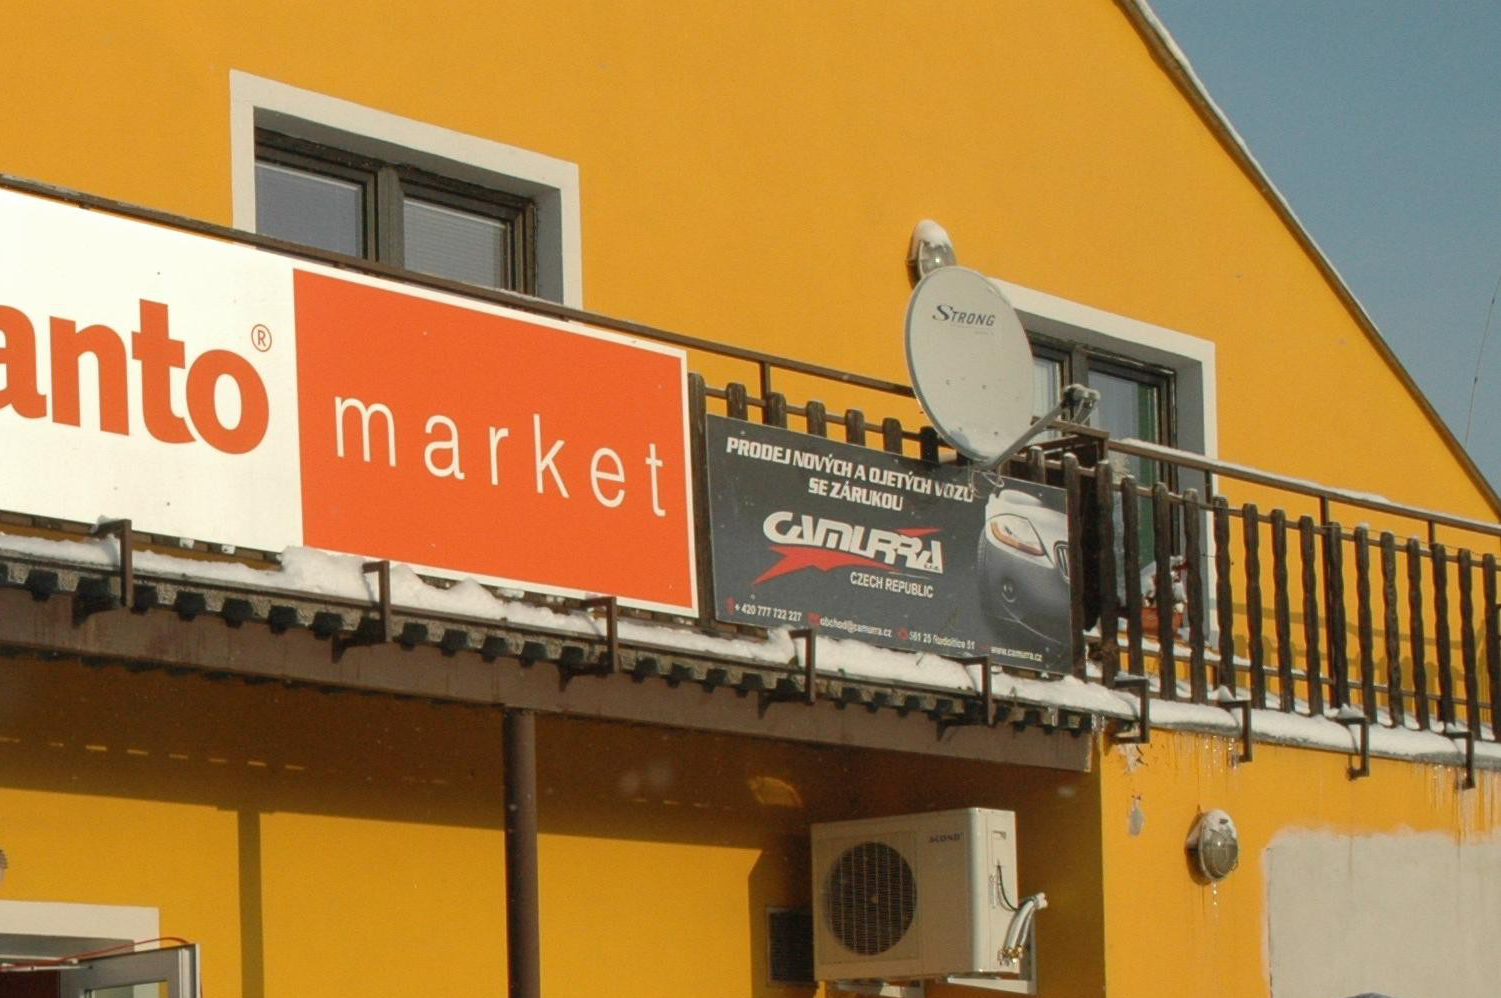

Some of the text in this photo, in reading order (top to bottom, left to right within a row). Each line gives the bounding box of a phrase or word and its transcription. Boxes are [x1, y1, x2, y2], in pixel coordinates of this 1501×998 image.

[334, 396, 666, 517] market
[726, 436, 791, 466] PRODEJ
[793, 446, 853, 479] NOVÝCH
[854, 464, 866, 481] A
[868, 463, 932, 497] OJETÝCH
[808, 478, 904, 513] SE ZÁRUKOU
[762, 510, 944, 575] CAMURRA
[850, 571, 935, 600] CZECH REPUBLIC
